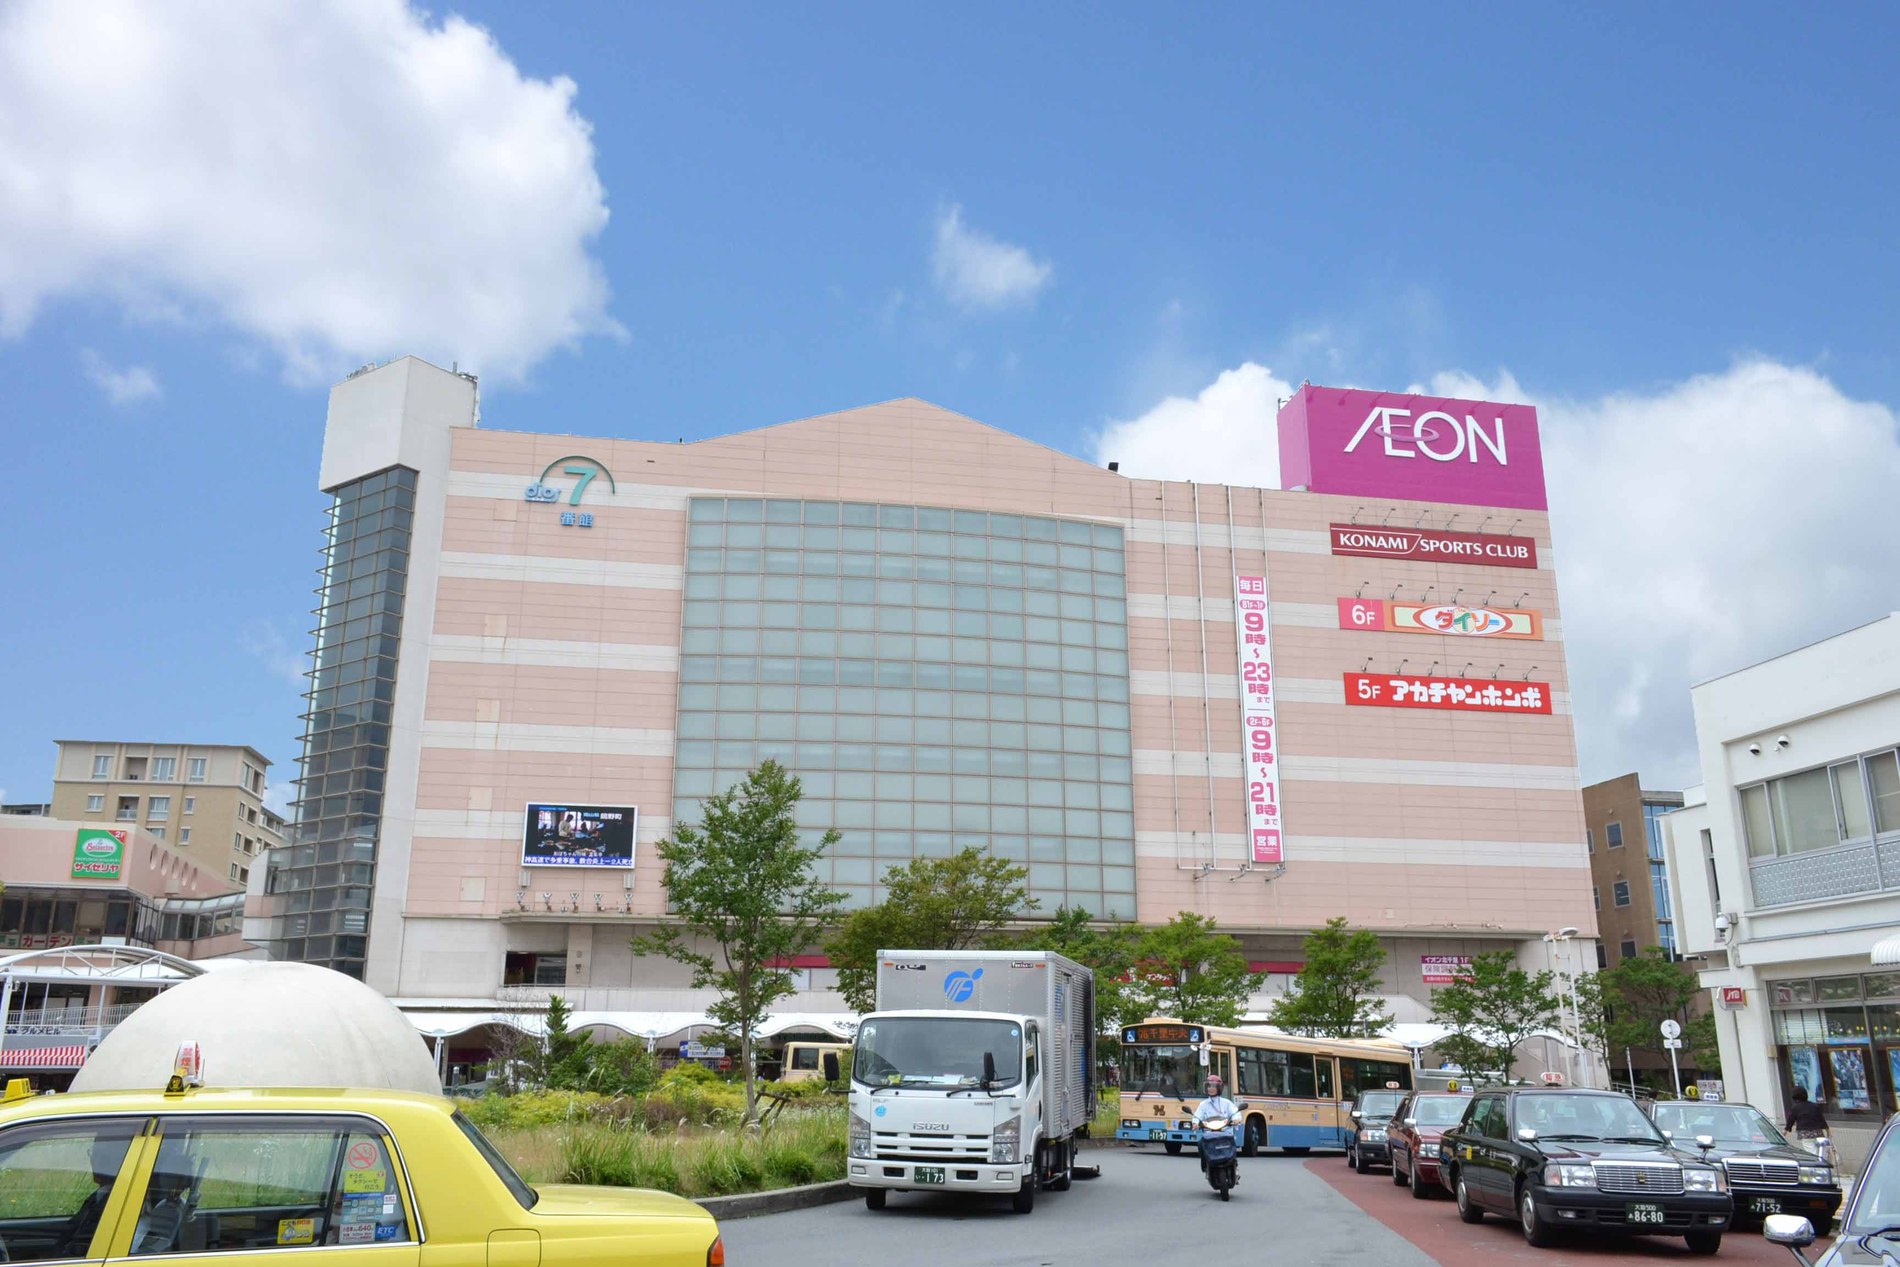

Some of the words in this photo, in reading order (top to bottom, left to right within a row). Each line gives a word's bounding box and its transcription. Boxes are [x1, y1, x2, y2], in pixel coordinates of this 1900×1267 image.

[563, 465, 597, 507] 7
[561, 511, 594, 527] 番館
[1339, 532, 1409, 550] KONAMI
[1420, 539, 1483, 556] SPORTS
[1485, 543, 1529, 559] CLUB
[1240, 580, 1263, 591] 毎日
[1352, 604, 1376, 626] 6F
[1435, 608, 1500, 632] ダイソー
[1358, 679, 1381, 700] 5F
[1256, 835, 1277, 847] 営業
[74, 862, 119, 873] サイゼリヤ
[1726, 989, 1740, 1001] JTB
[913, 1122, 949, 1131] ISUZU
[1756, 1203, 1780, 1213] 71-52
[1634, 1211, 1663, 1222] 86-80
[377, 1226, 395, 1234] ETC
